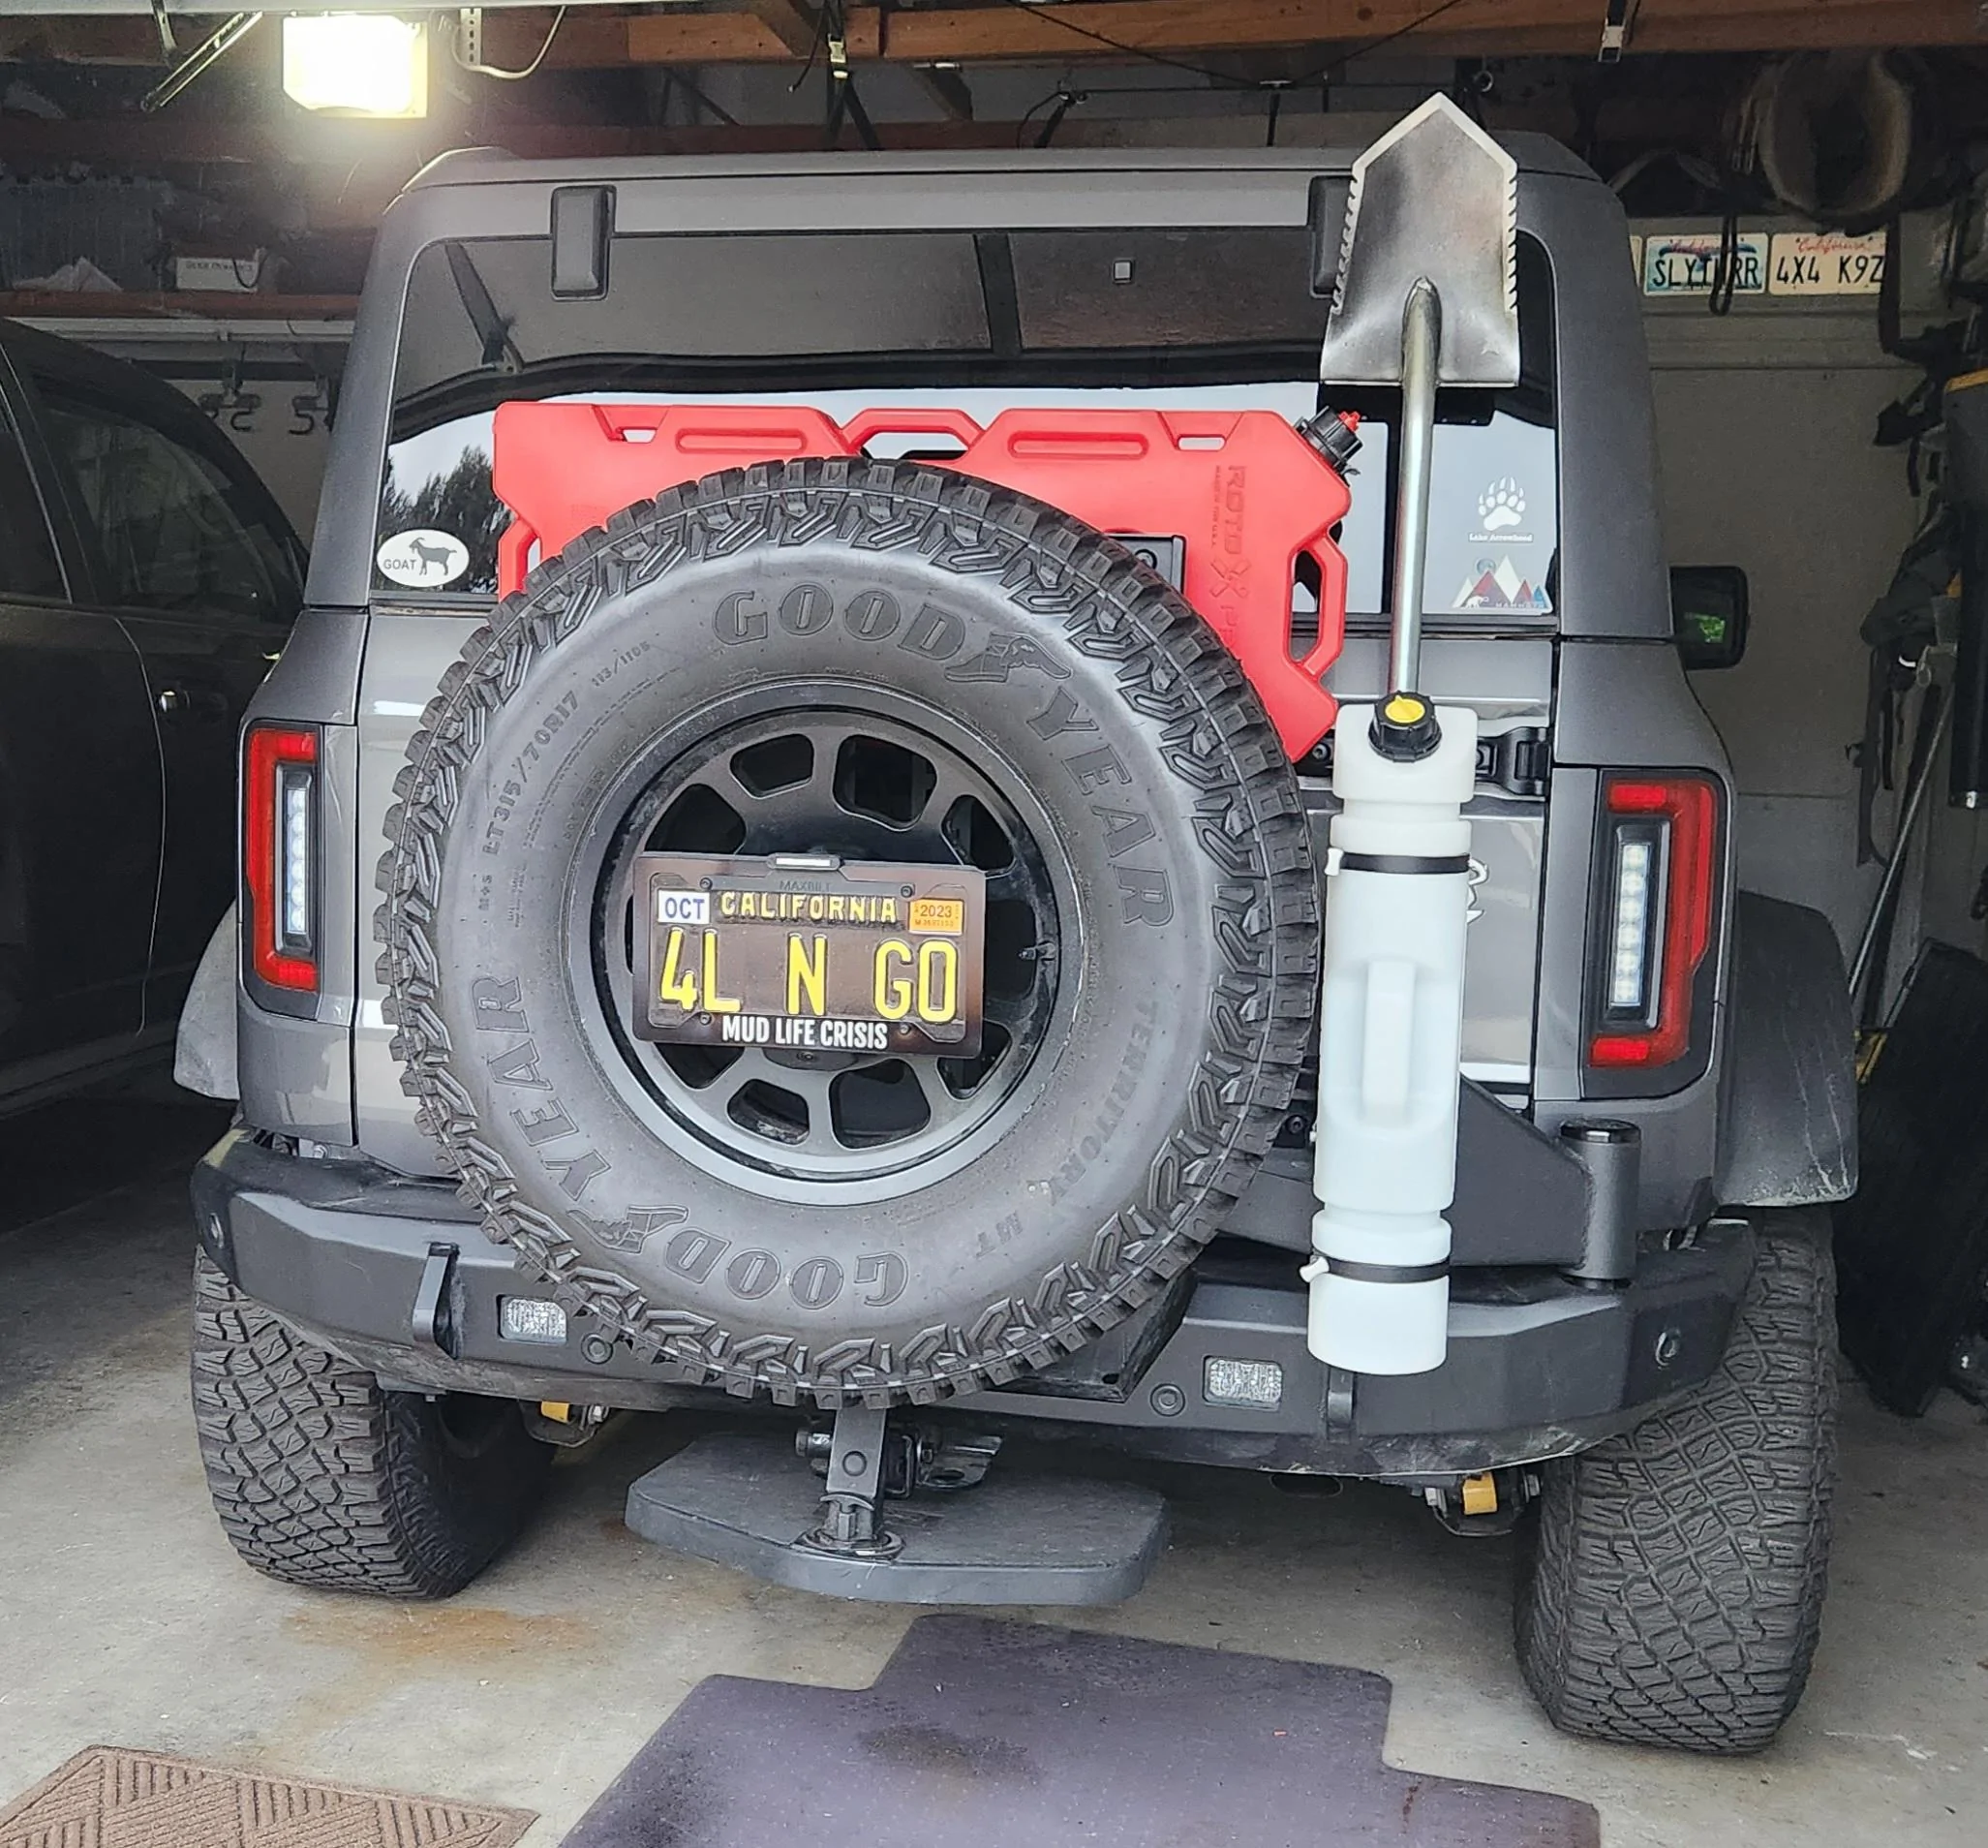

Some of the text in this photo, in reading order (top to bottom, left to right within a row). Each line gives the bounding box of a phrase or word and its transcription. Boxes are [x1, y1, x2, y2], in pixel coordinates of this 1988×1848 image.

[1776, 255, 1884, 284] 4X4 K9Z
[382, 559, 417, 570] GOAT
[664, 896, 706, 920] OCT
[719, 890, 898, 925] CALIFORNIA
[920, 904, 952, 918] 2023
[659, 926, 742, 1013] 4L
[785, 932, 827, 1016] N
[873, 938, 958, 1024] GO
[721, 1015, 888, 1050] MUD LIFE CRISIS
